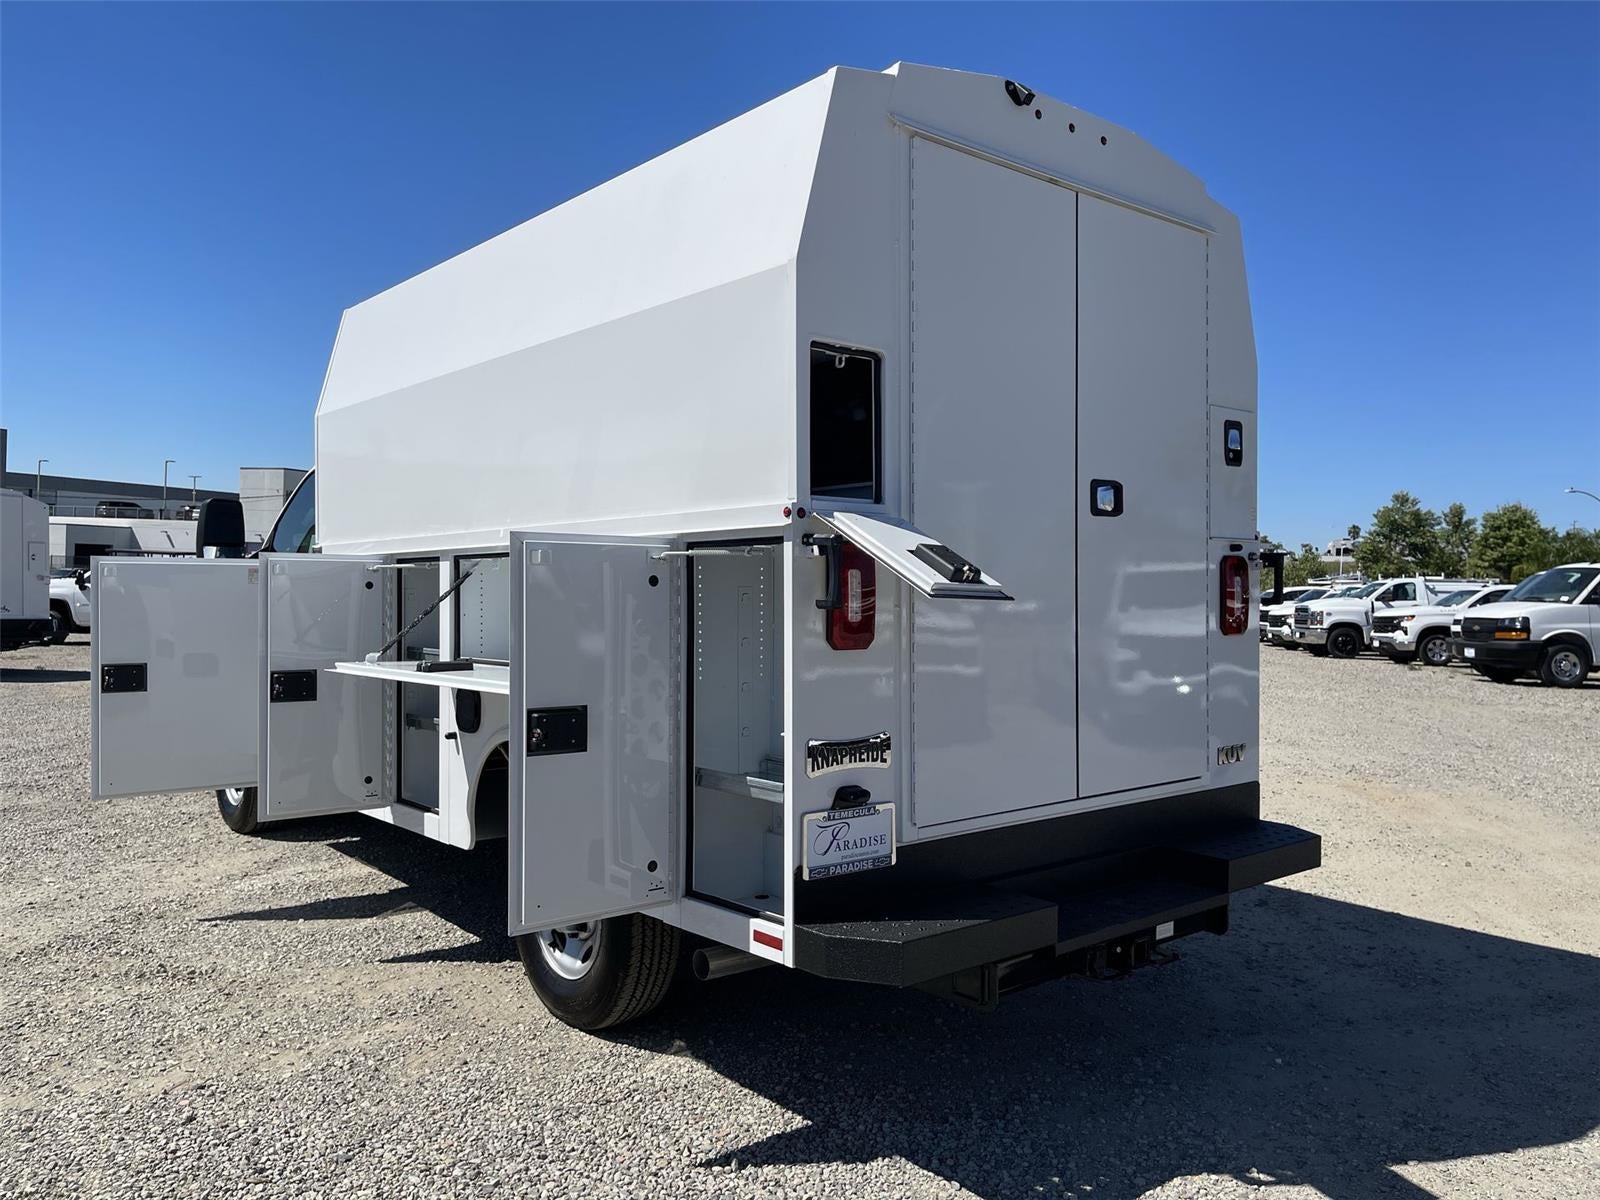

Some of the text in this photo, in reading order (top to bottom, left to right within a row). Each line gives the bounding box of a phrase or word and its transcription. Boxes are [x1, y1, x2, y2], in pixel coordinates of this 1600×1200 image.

[808, 740, 889, 772] KNAPHEIDE
[829, 807, 875, 819] TEMECULA
[813, 821, 887, 856] PARADISE
[829, 859, 873, 875] PARADISE
